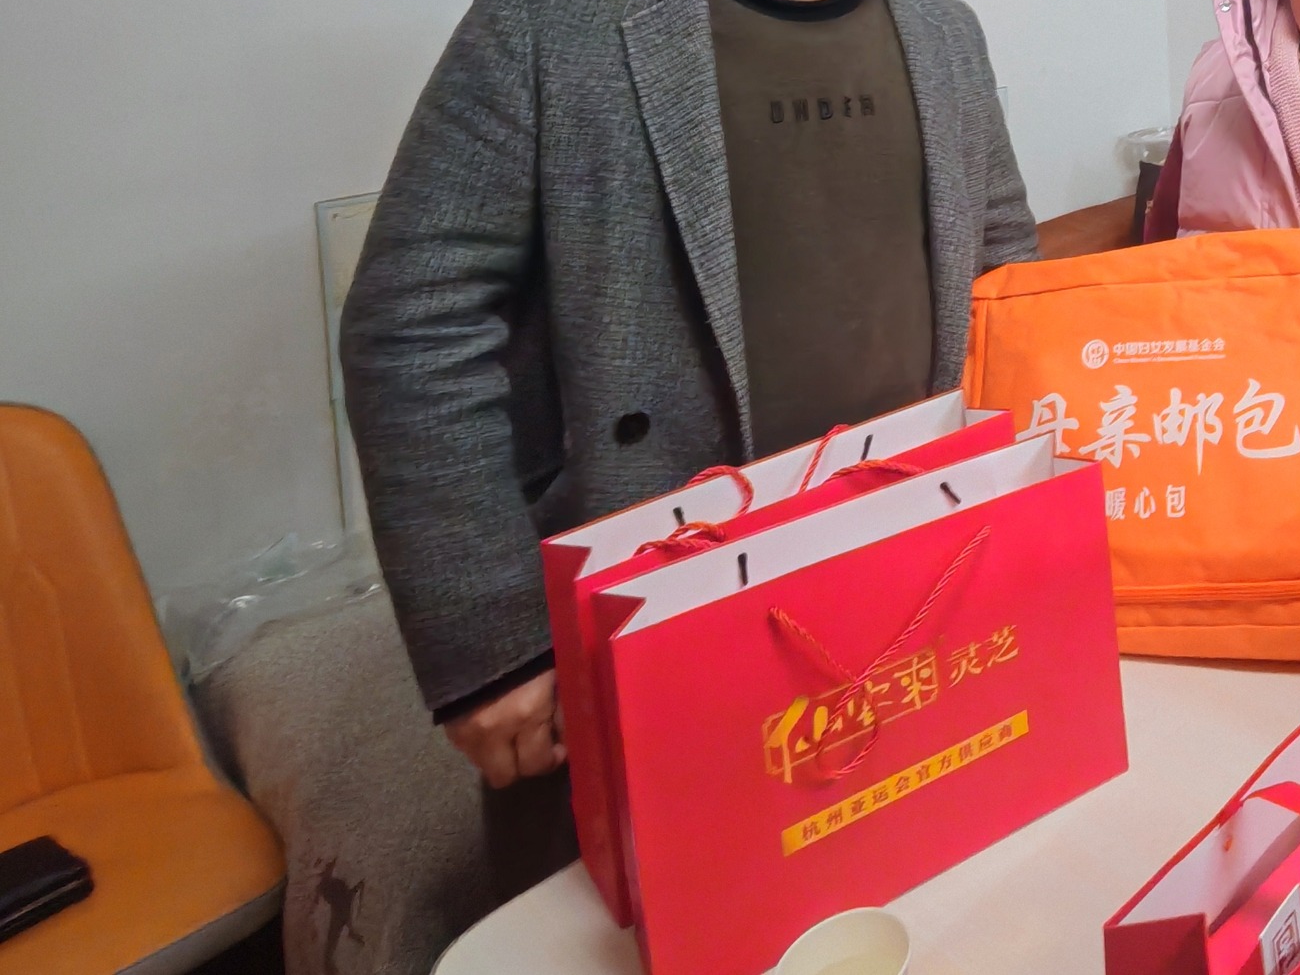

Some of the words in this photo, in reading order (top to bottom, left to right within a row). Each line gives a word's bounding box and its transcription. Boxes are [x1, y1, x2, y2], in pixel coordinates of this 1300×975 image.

[1113, 338, 1225, 356] 中国妇女发展基金会
[1105, 485, 1186, 521] 暖心包
[947, 625, 1019, 688] 灵芝
[802, 725, 1013, 841] 杭州亚运会官方供应商
